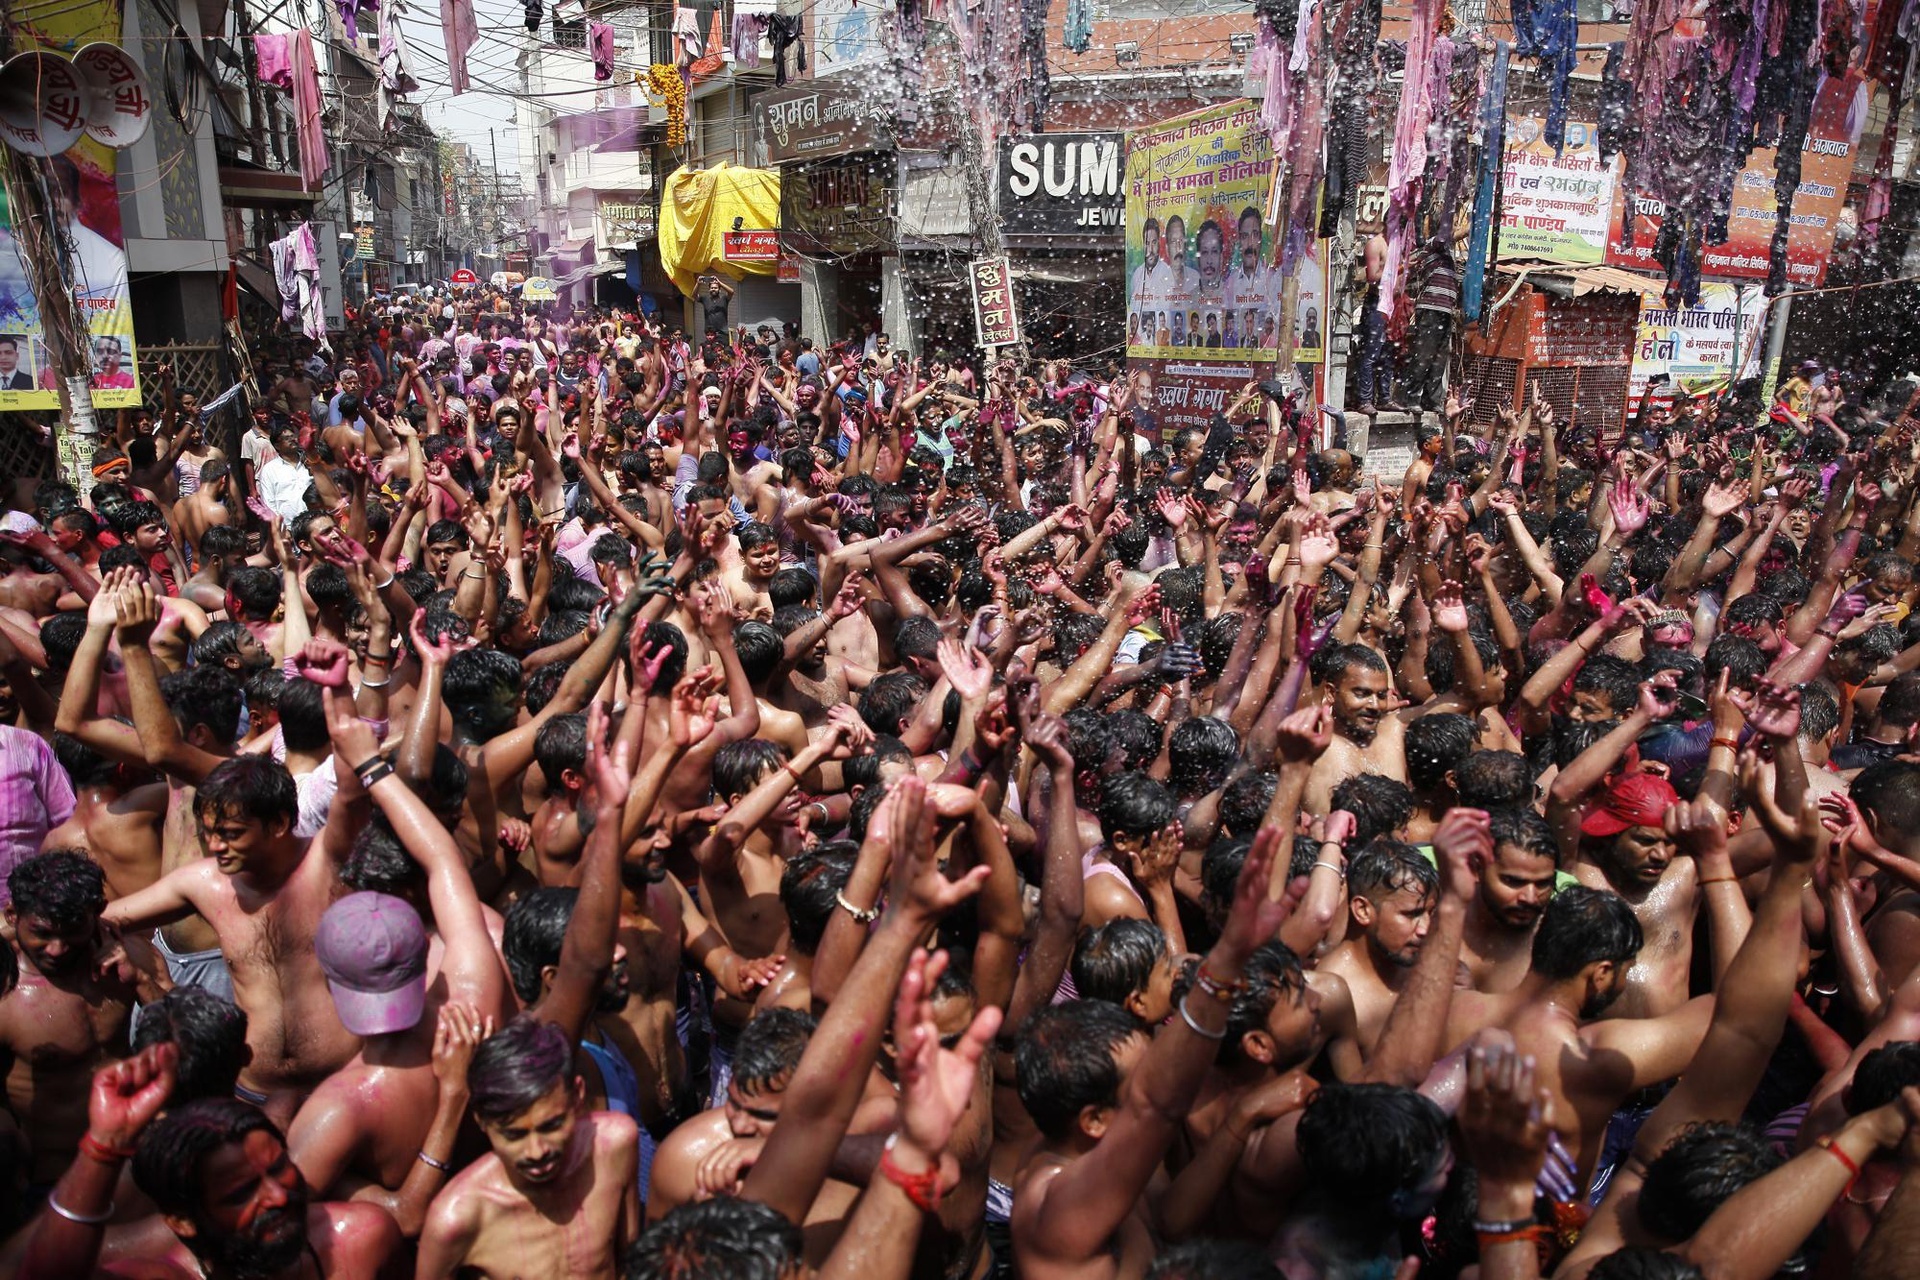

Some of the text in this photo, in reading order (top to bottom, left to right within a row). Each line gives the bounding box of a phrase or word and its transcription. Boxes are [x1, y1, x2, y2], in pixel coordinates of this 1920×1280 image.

[768, 93, 821, 147] सुमन
[1190, 119, 1228, 139] मिलन
[1212, 136, 1224, 150] की
[1196, 150, 1241, 168] ऐतिहासिक
[1009, 142, 1125, 197] SUM
[1132, 179, 1143, 197] में
[1145, 175, 1171, 195] आये
[1175, 170, 1214, 191] समस्त
[1520, 175, 1543, 190] एवं
[1819, 186, 1835, 197] 2021
[1170, 193, 1195, 206] स्वागत
[1523, 213, 1567, 232] पाण्डेय
[1681, 309, 1711, 328] भारत
[1641, 330, 1680, 361] होली
[1685, 336, 1694, 349] के
[1699, 353, 1720, 363] करता
